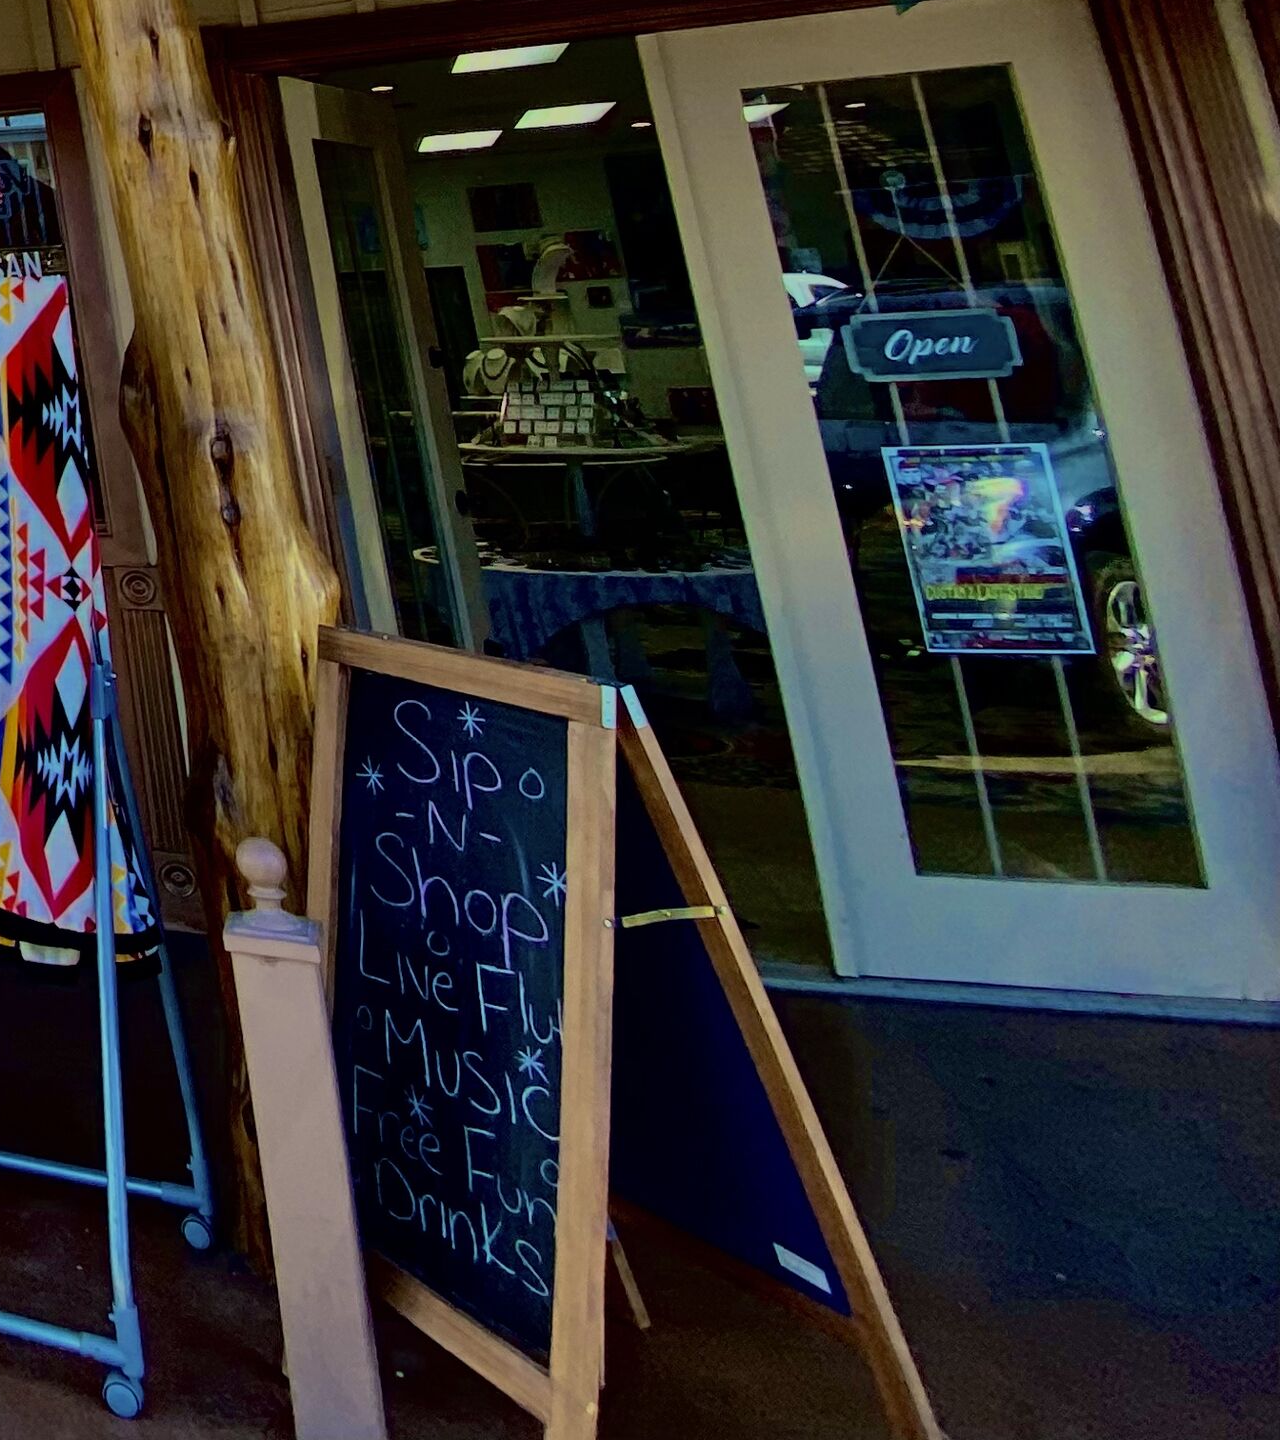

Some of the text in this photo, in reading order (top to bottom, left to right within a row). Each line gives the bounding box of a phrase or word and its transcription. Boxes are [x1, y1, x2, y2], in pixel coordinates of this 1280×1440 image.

[884, 329, 979, 365] Open
[394, 699, 502, 811] Sip
[370, 832, 549, 970] Shop
[354, 1064, 443, 1176] Free
